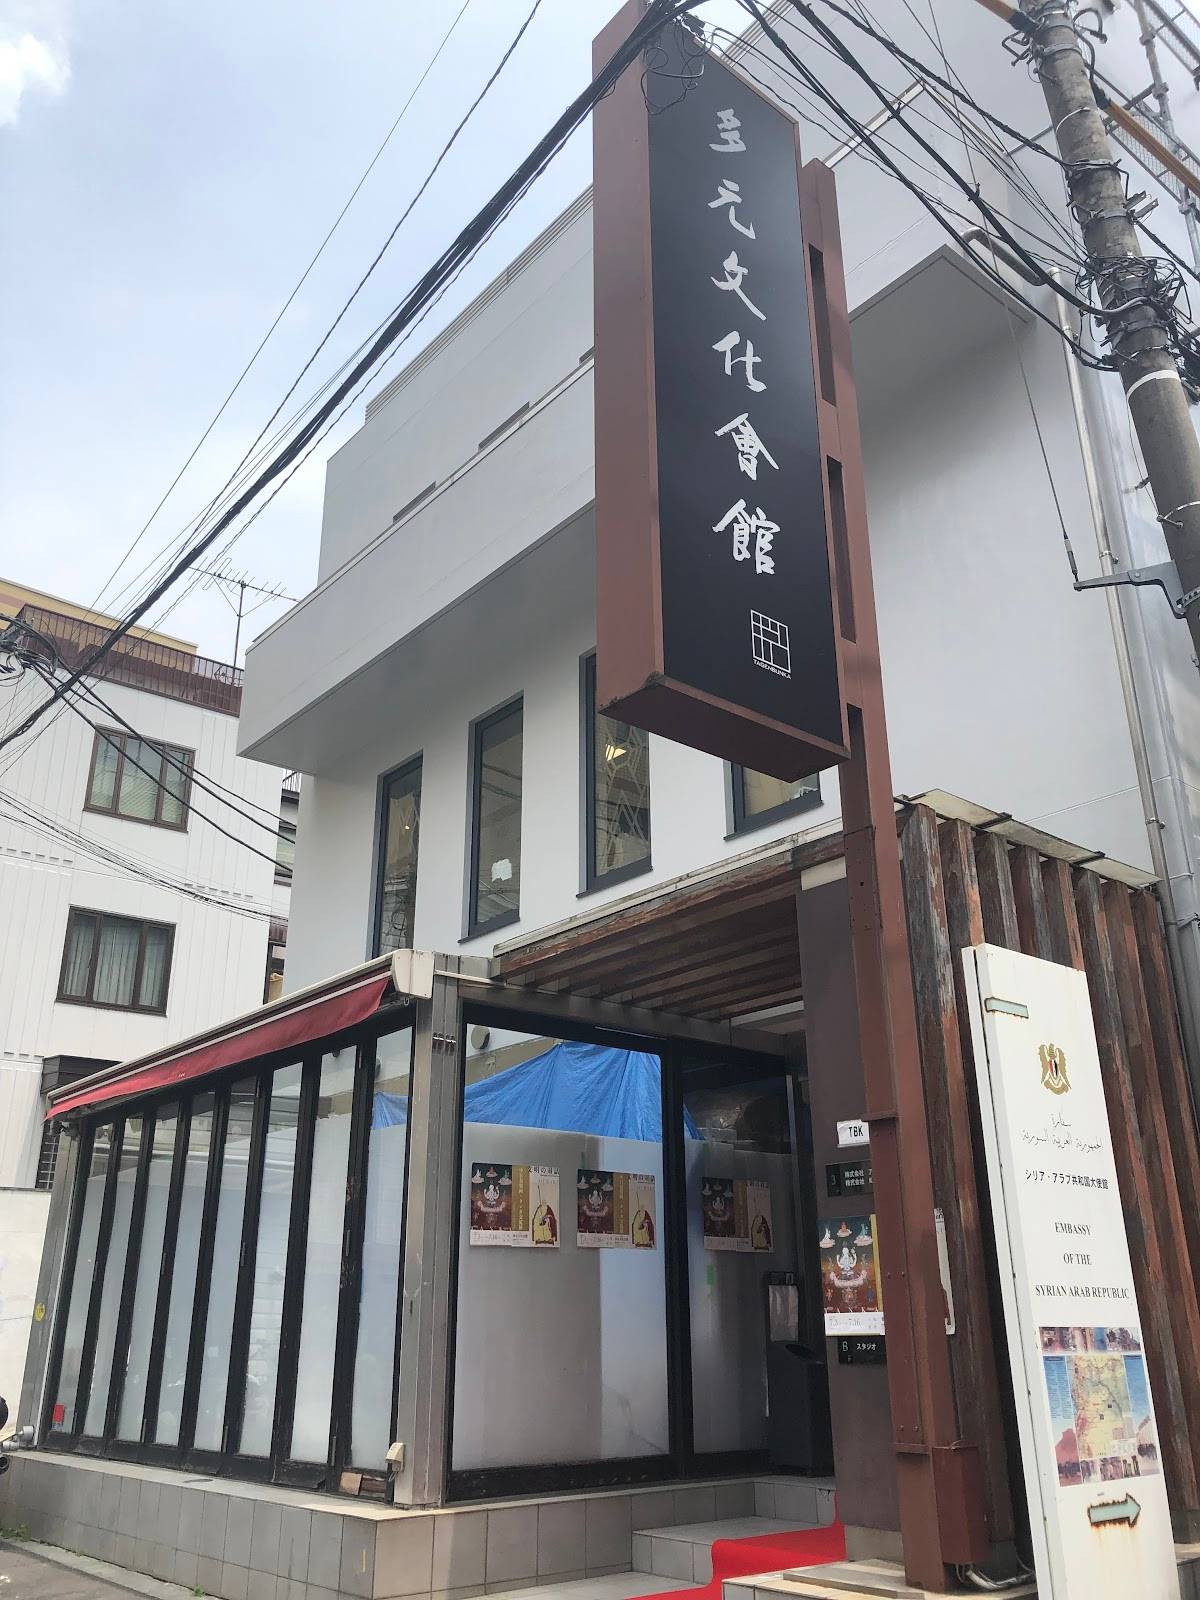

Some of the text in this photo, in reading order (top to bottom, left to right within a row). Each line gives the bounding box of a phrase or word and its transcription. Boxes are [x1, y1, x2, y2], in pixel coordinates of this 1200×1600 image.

[848, 1125, 864, 1137] TBK
[1054, 1222, 1091, 1236] EMBASSY
[1063, 1252, 1092, 1266] OF THE
[1035, 1284, 1130, 1299] SYRIAN ARAB REPUBLIC
[856, 1343, 877, 1351] スタジオ
